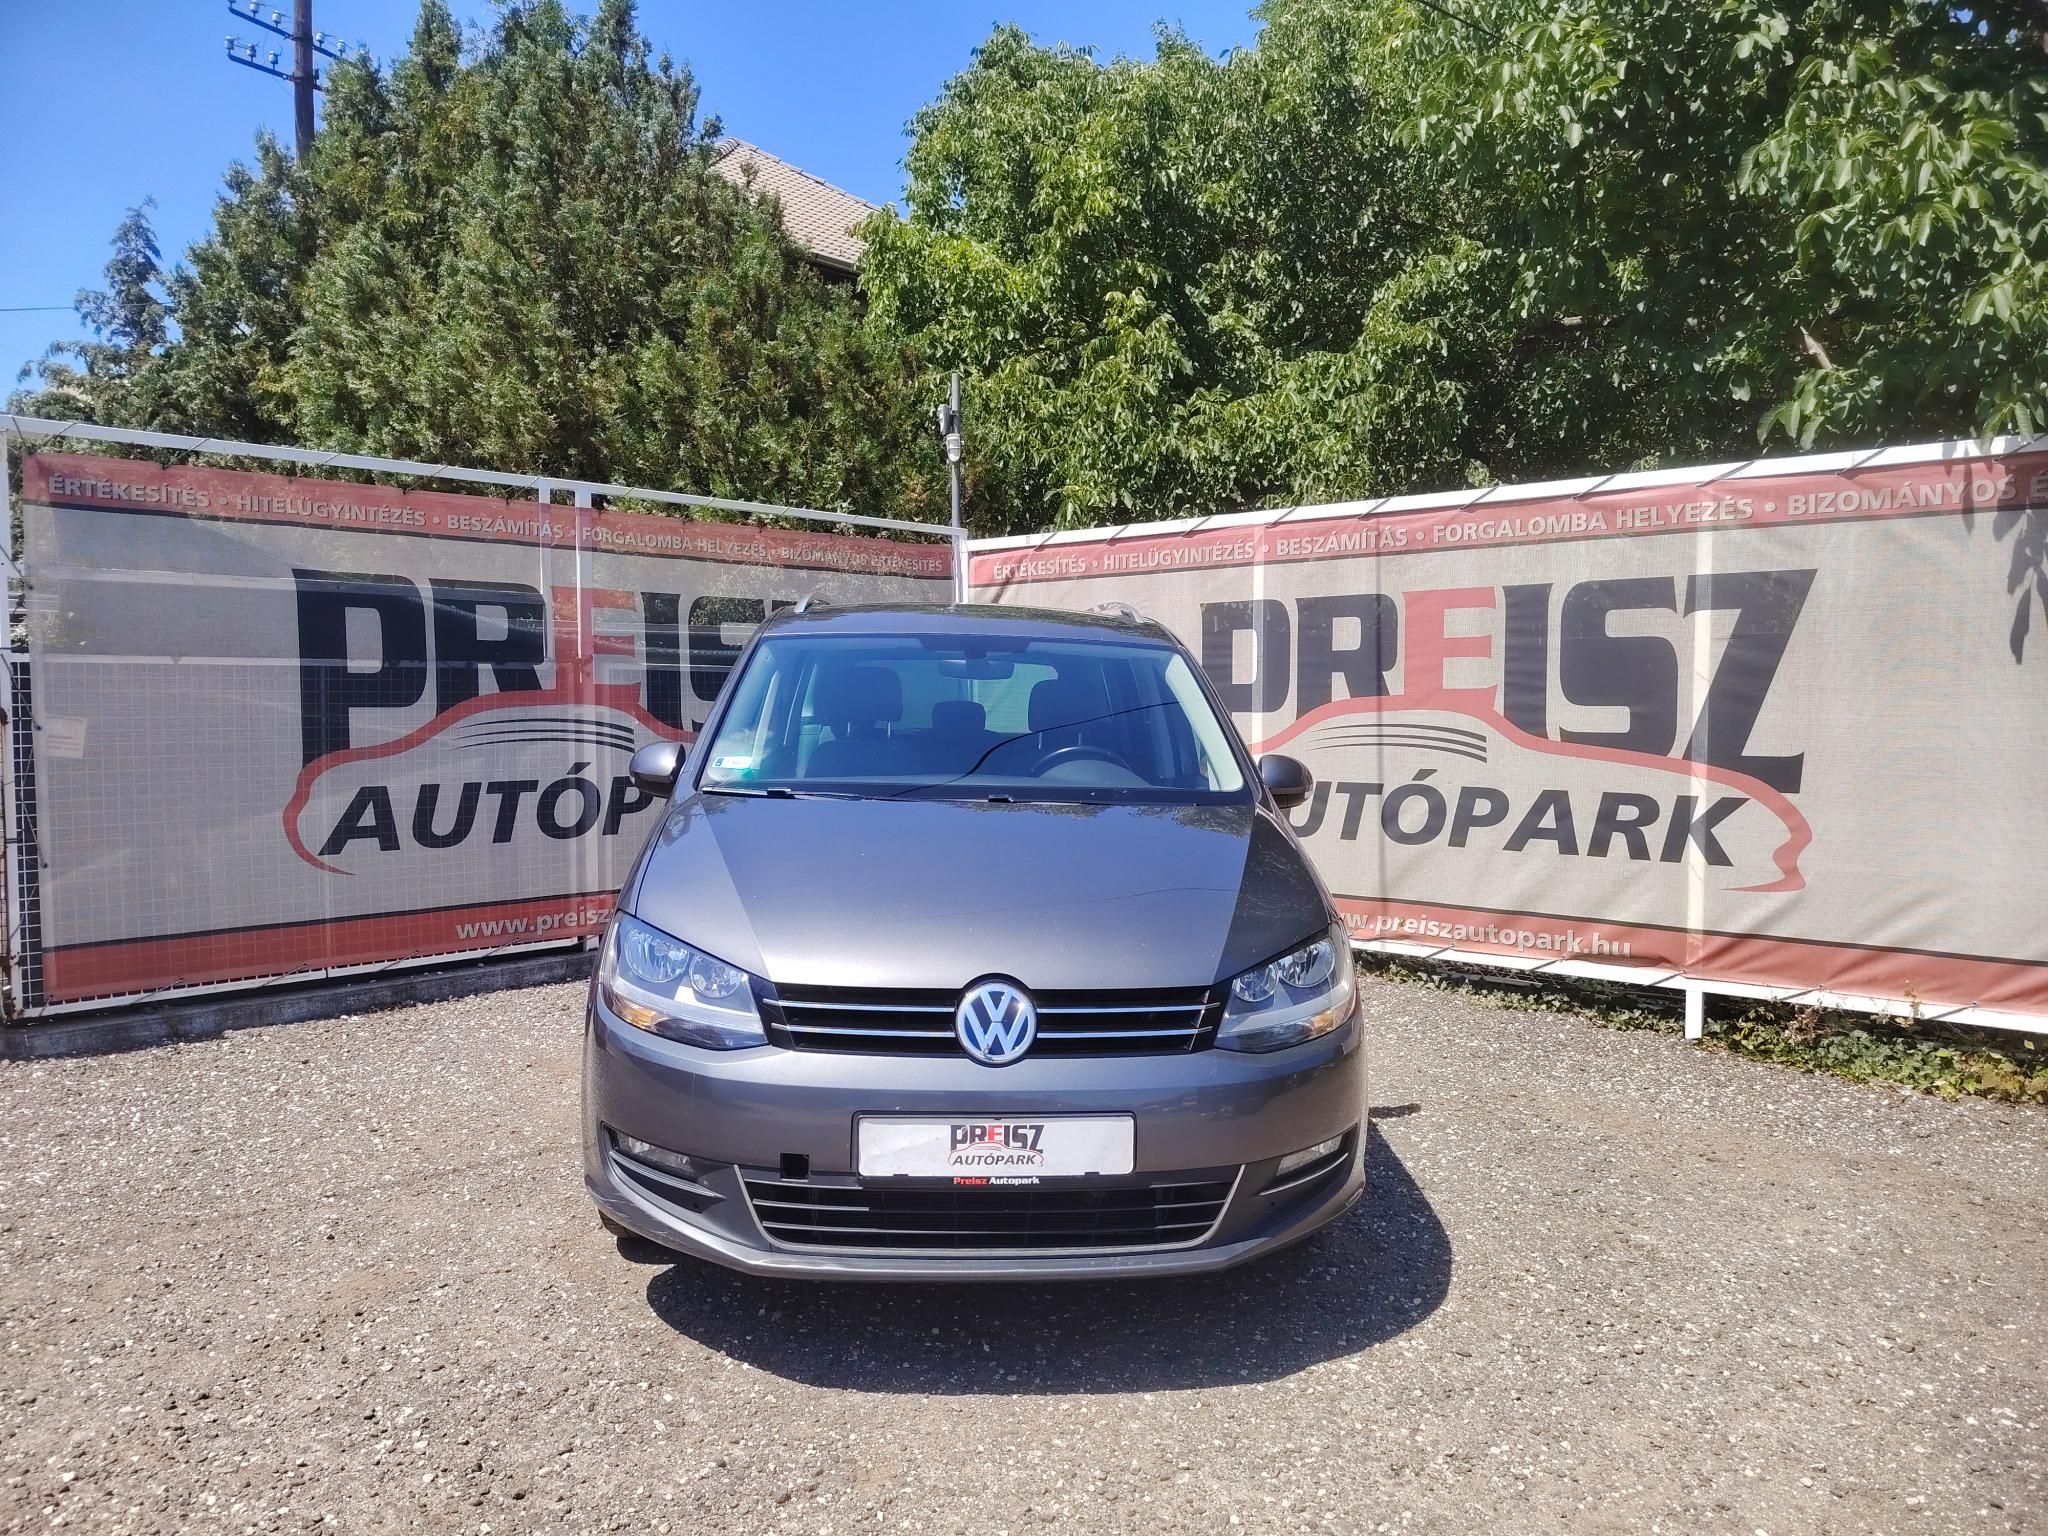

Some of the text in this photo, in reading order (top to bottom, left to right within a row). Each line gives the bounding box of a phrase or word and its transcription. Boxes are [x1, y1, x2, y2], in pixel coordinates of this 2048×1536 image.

[49, 473, 211, 508] ÉRTÉKESÍTÉS
[237, 495, 426, 527] HITELÜGYINTÉZÉS
[447, 513, 564, 539] BESZÁMÍTÁS
[582, 527, 692, 551] FORGALOMBA
[993, 554, 1087, 580] ÉRTÉKESÍTÉS
[1103, 539, 1256, 571] HITELÜGYINTÉZÉS
[1276, 524, 1409, 557] BESZÁMÍTÁS
[1432, 511, 1607, 544] FORGALOMBA
[1616, 495, 1754, 529] HELYEZÉS
[1786, 474, 2018, 517] BIZOMÁNYOS
[292, 568, 820, 769] PREIS
[1200, 569, 1818, 794] PREISZ
[455, 906, 613, 940] www.preisz
[950, 1124, 1045, 1153] PREISZ
[952, 1152, 1037, 1167] AUTÓPARK
[953, 1176, 1040, 1187] Preisz Autopark
